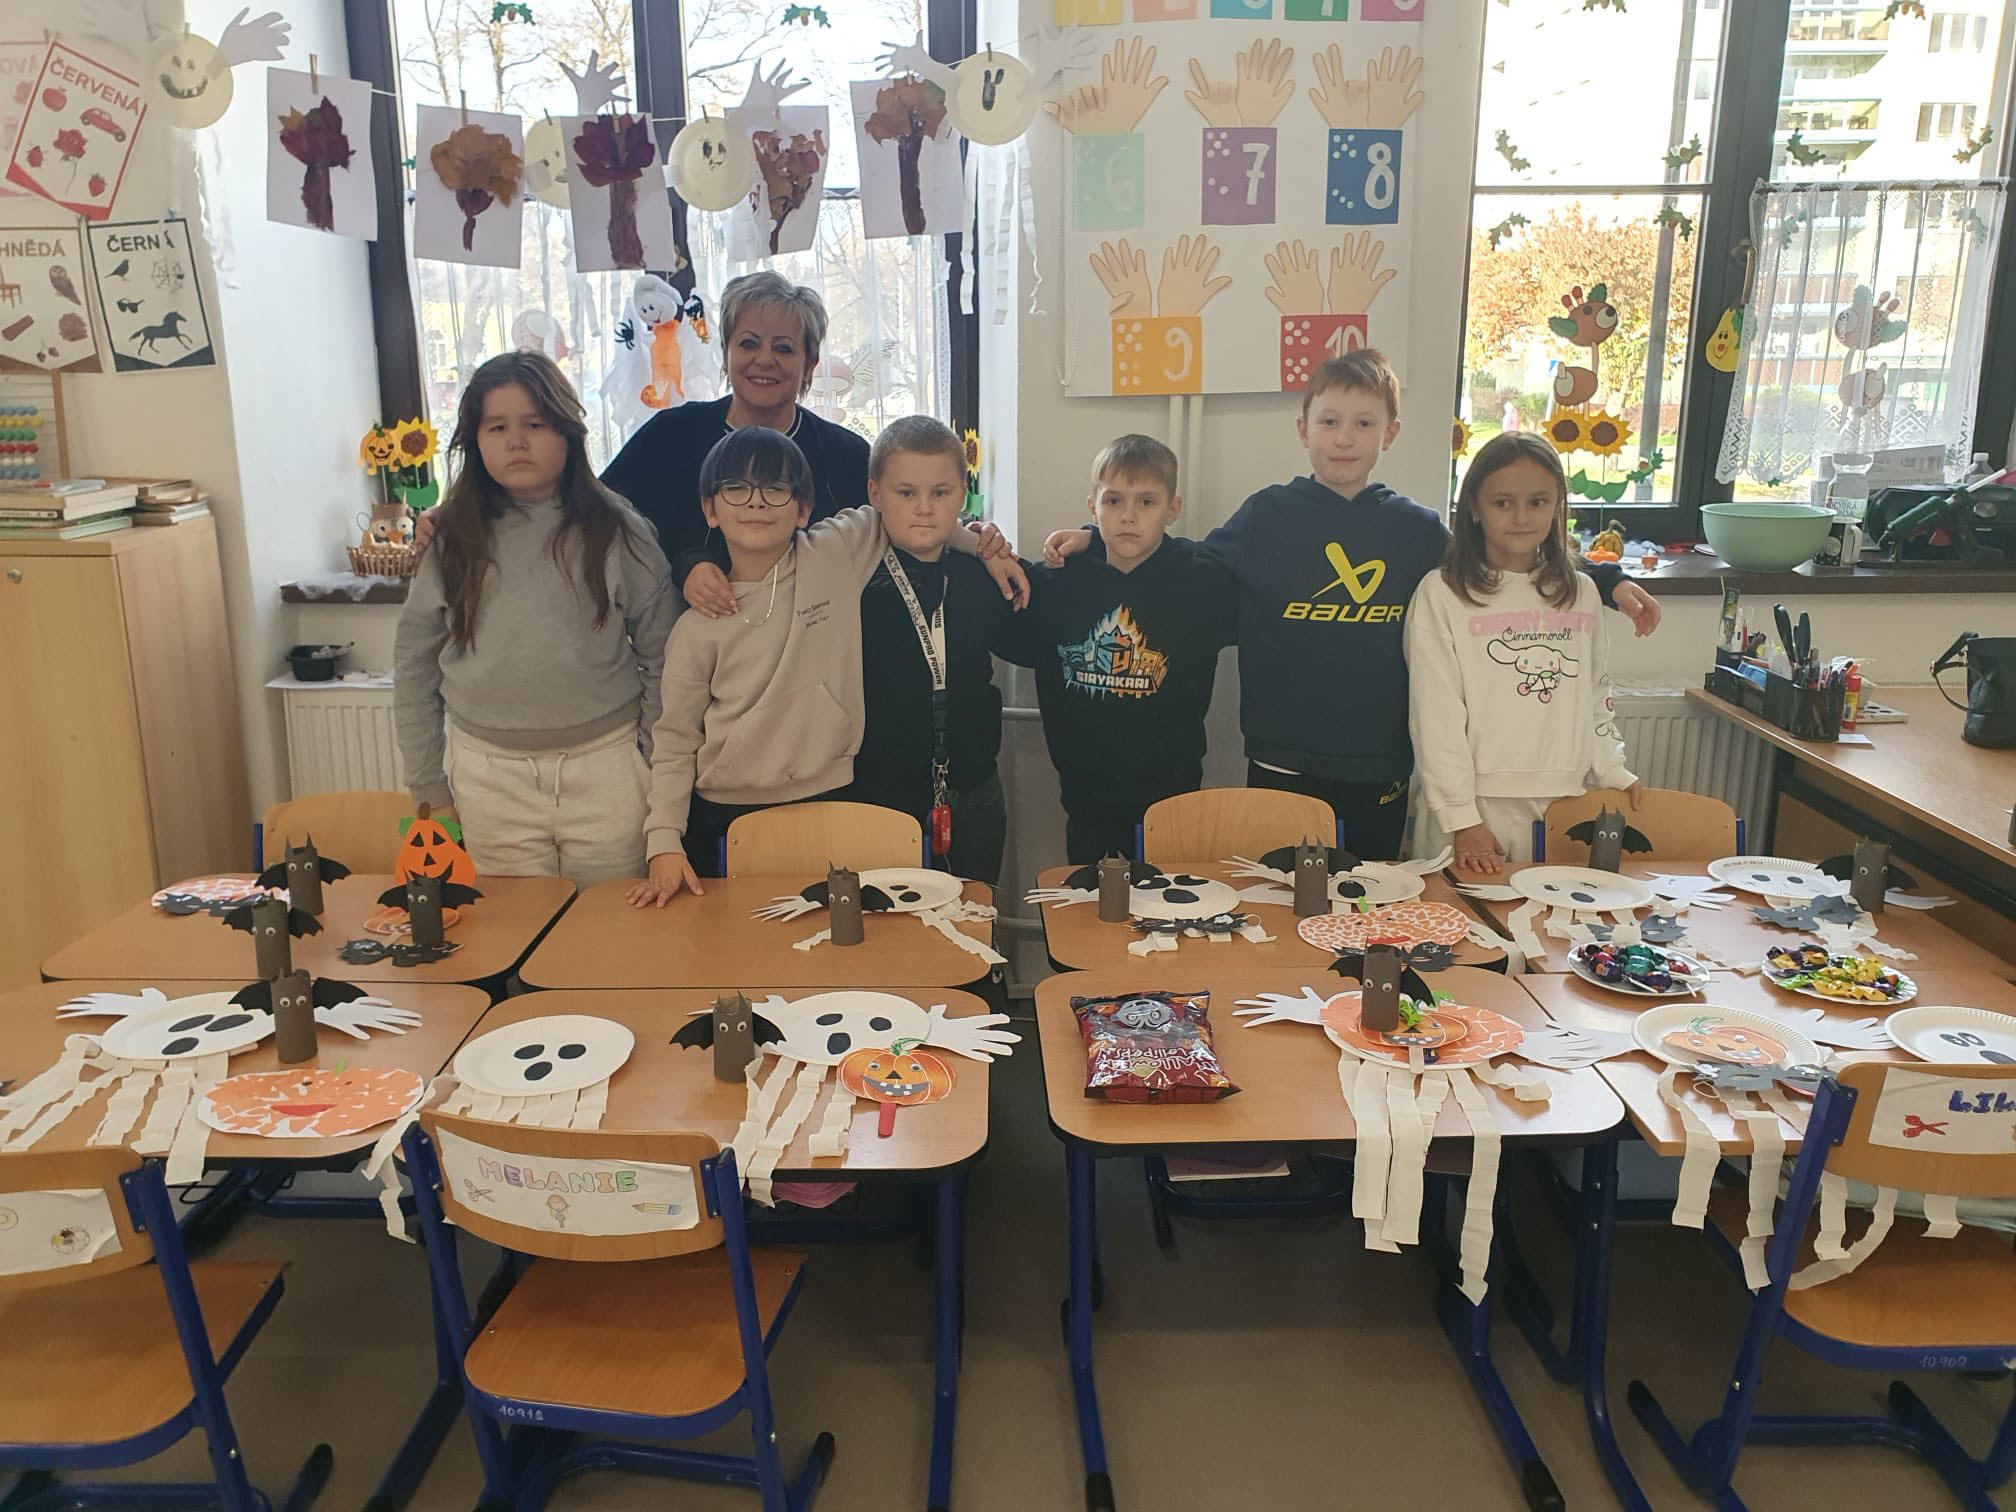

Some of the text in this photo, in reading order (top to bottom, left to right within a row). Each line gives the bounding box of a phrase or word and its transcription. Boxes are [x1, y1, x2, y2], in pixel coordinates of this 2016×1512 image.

[1105, 145, 1137, 212] 6
[1242, 142, 1271, 206] 7
[1364, 142, 1396, 210] 8
[1162, 325, 1193, 383] 9
[929, 656, 943, 685] POWER
[478, 1156, 639, 1194] MELANIE
